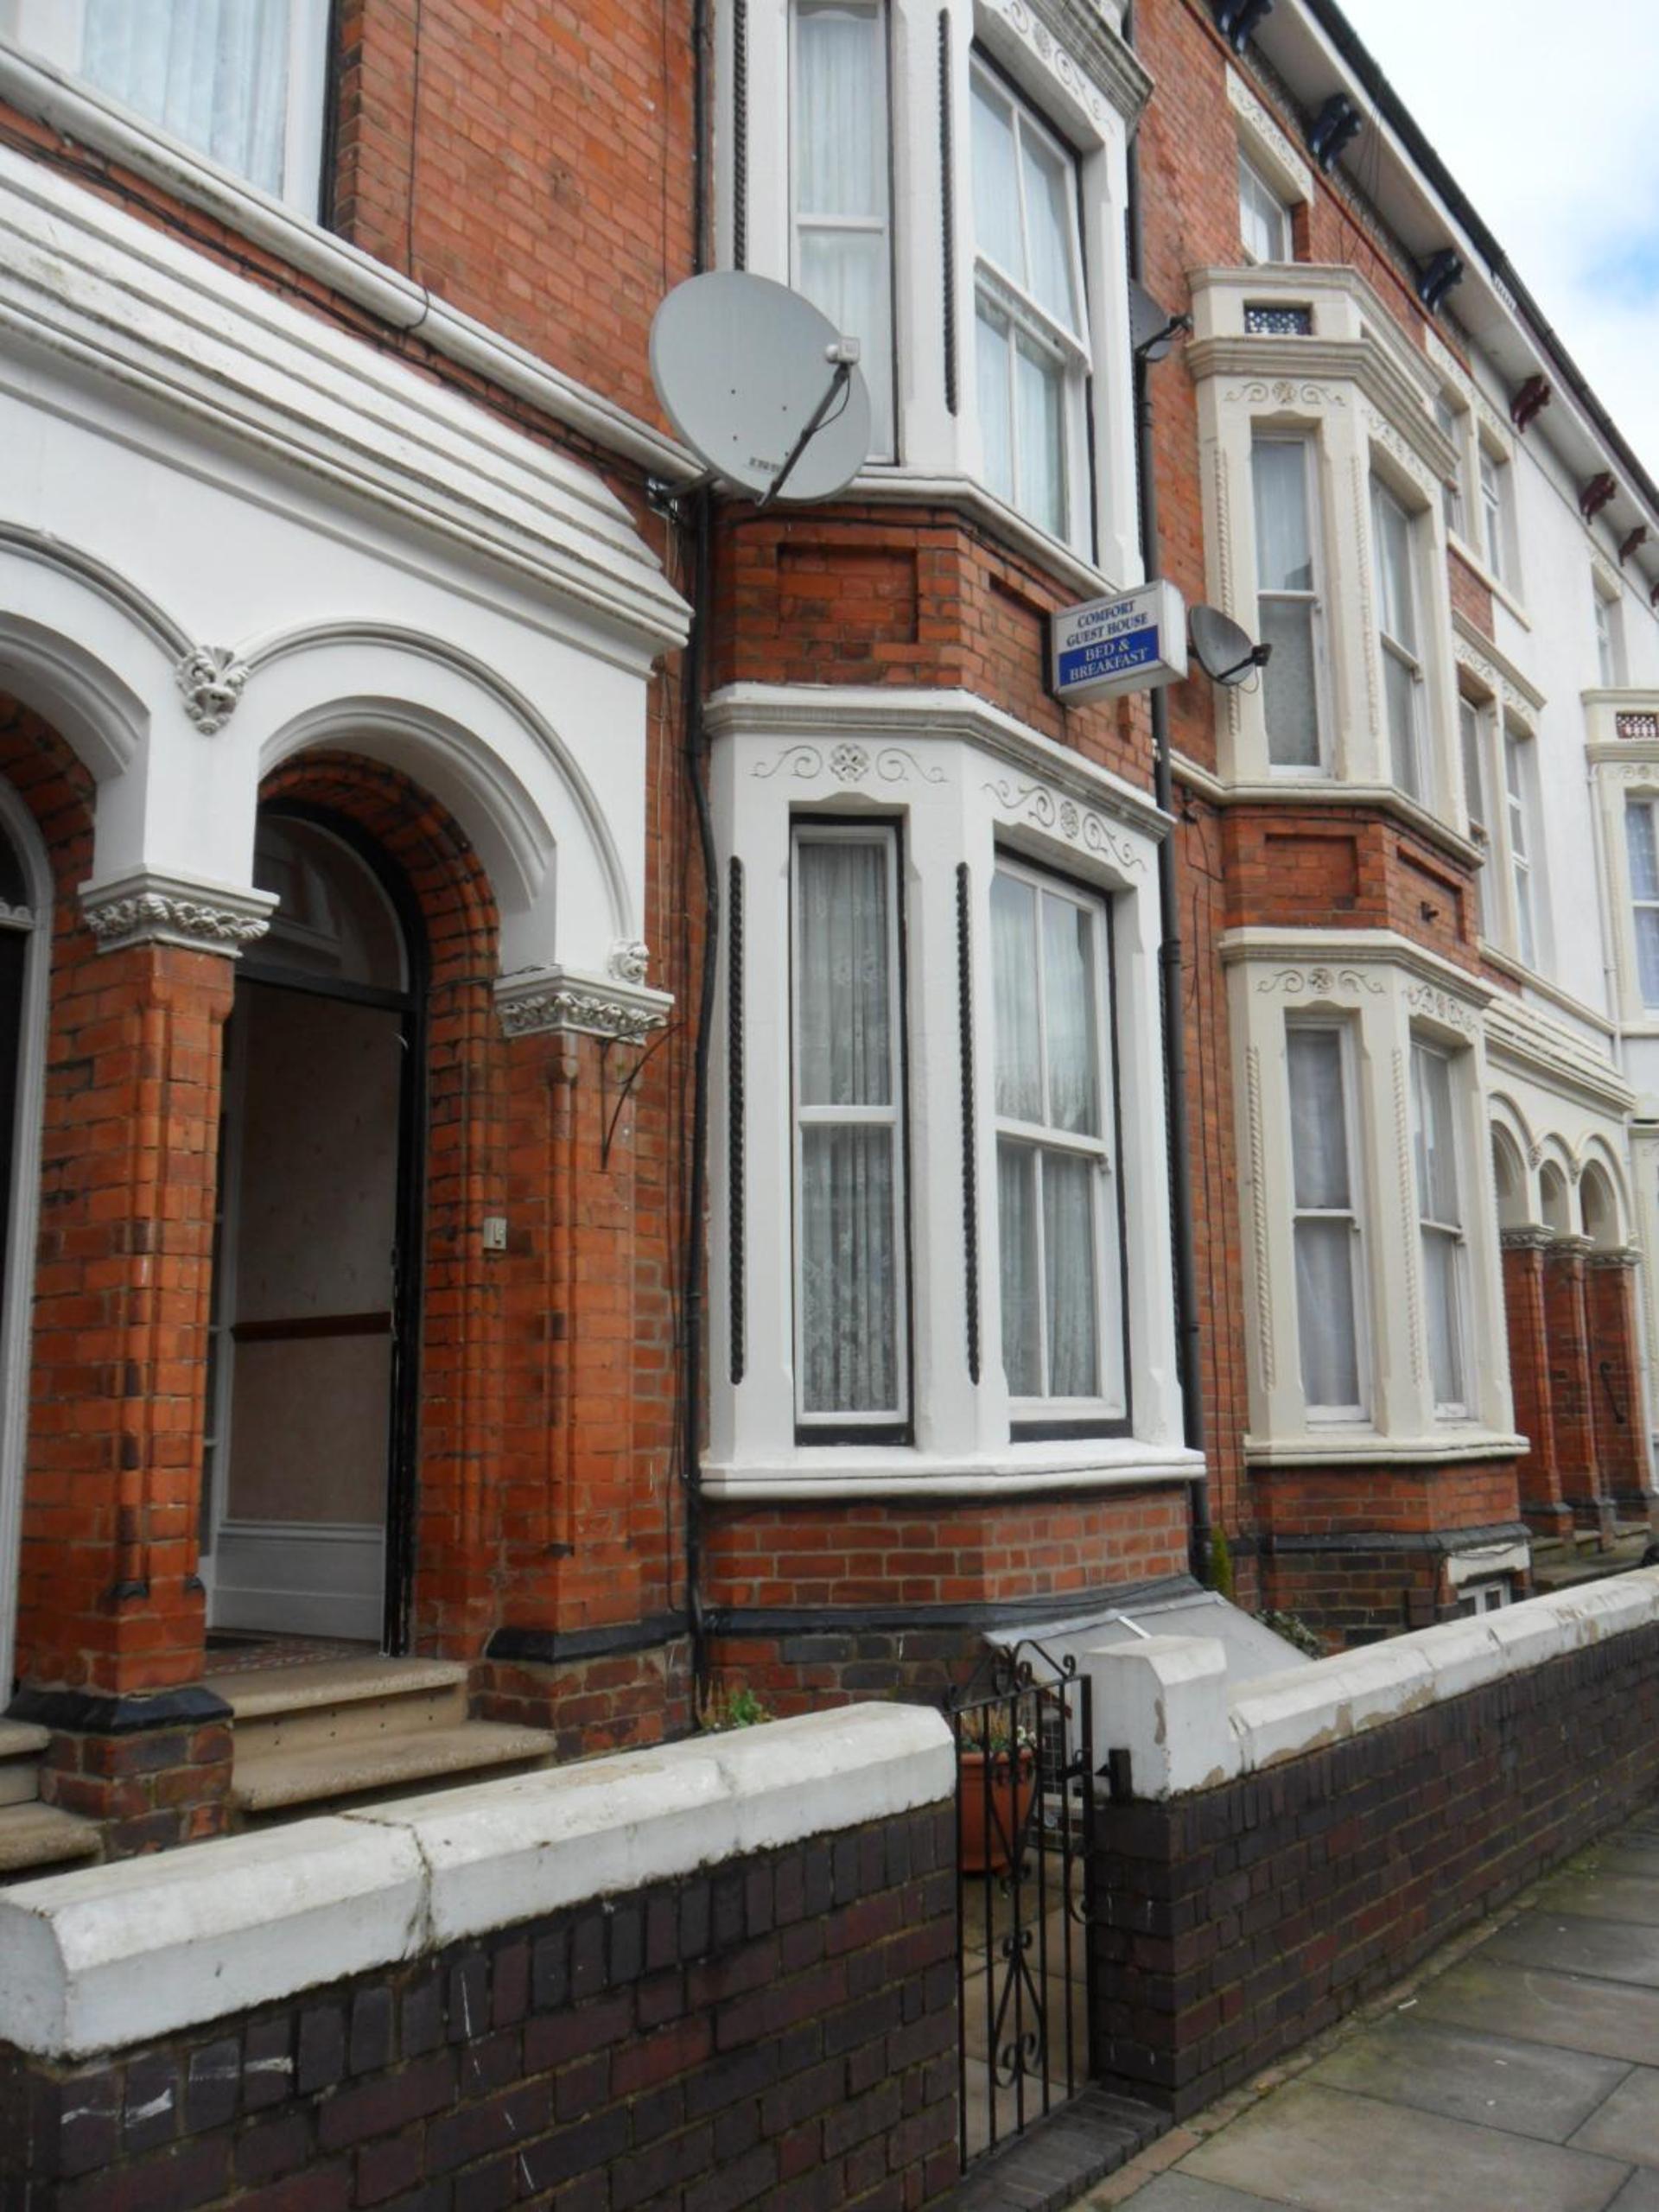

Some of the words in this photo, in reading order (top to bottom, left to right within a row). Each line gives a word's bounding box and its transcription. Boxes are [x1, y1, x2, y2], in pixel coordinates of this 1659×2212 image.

[1077, 601, 1135, 627] COMFORT
[1066, 626, 1106, 647] GUEST
[1107, 613, 1148, 635] HOUSE
[1069, 648, 1147, 681] BREAKFAST
[1085, 642, 1115, 661] BED
[1118, 639, 1130, 652] &
